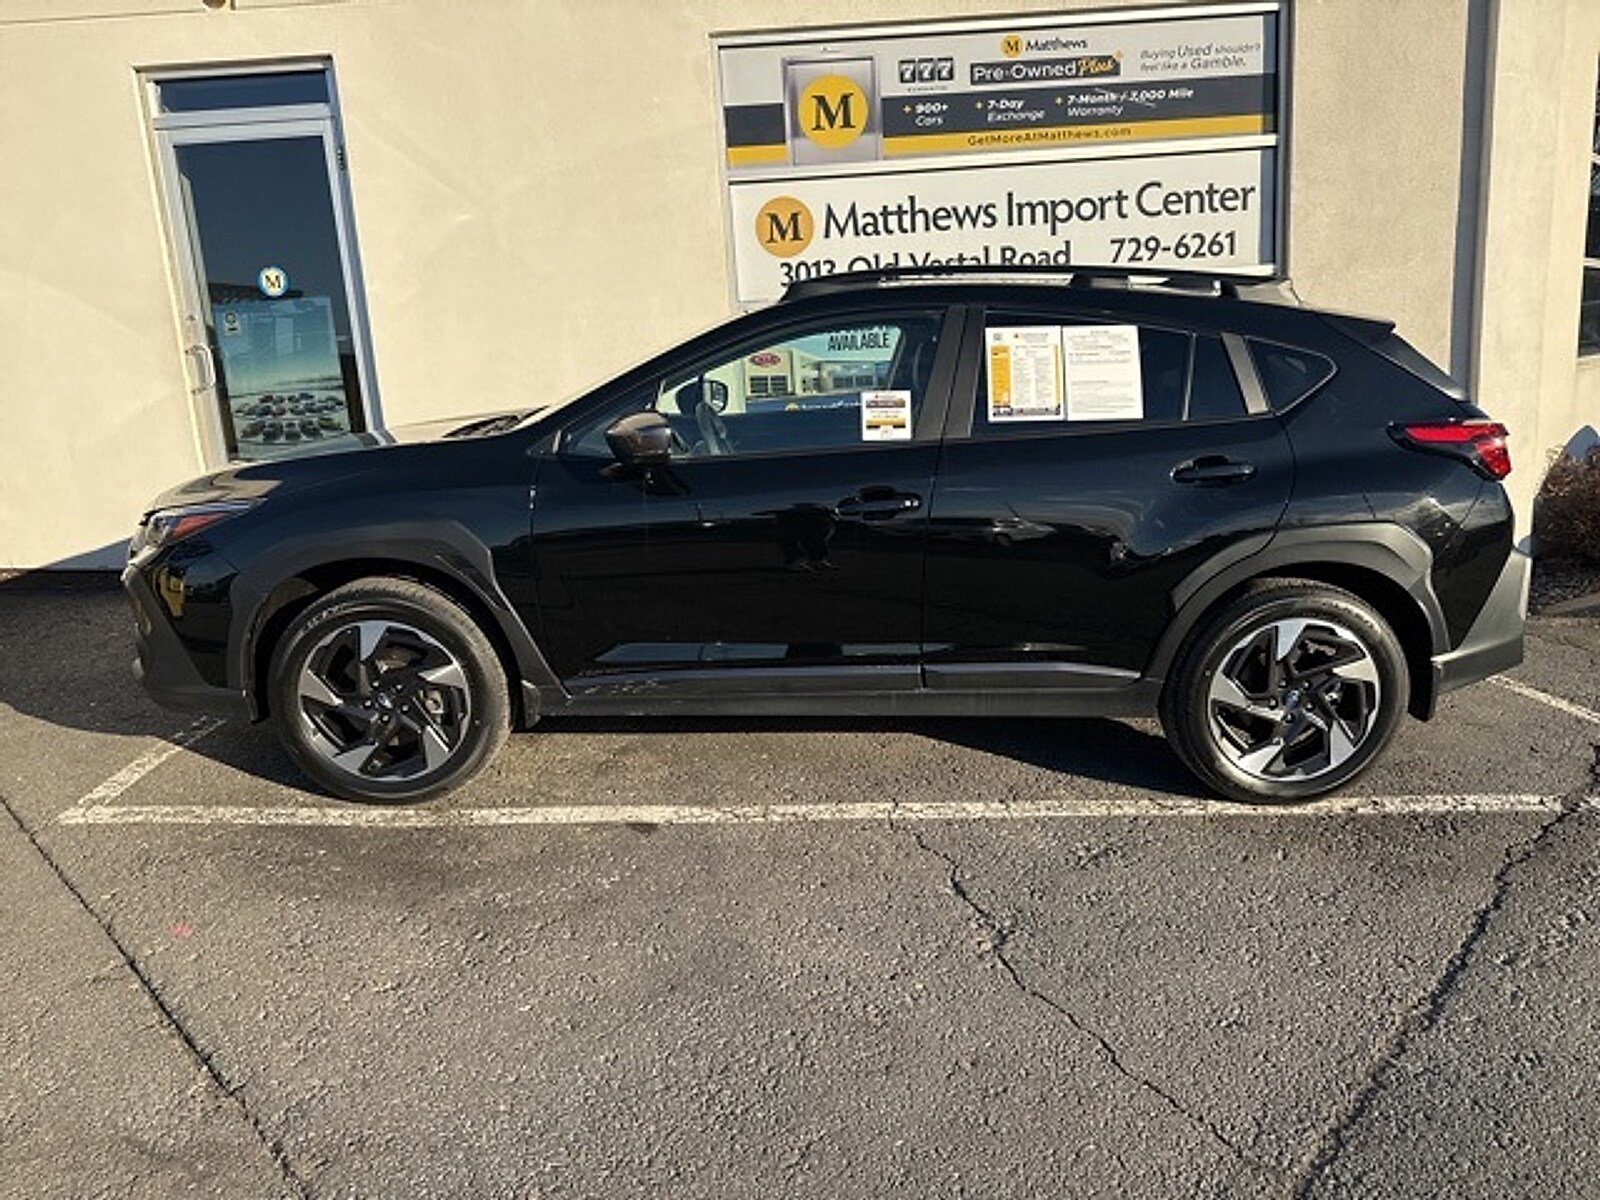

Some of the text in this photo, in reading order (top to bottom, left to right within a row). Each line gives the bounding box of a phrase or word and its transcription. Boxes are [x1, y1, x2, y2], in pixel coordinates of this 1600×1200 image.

[1025, 38, 1087, 52] Matthews
[1177, 42, 1213, 58] Used
[901, 60, 953, 82] 777
[972, 60, 1076, 81] Pre-Owned
[811, 92, 856, 131] M
[987, 99, 1024, 111] 7-Day
[1067, 104, 1123, 116] Warranty
[915, 115, 944, 126] Cars
[987, 109, 1045, 122] Exchange
[823, 181, 1256, 239] Matthews Import Center
[765, 210, 804, 244] M
[1000, 240, 1071, 266] Road
[1110, 231, 1236, 263] 729-6261
[828, 332, 891, 352] AVAILABLE
